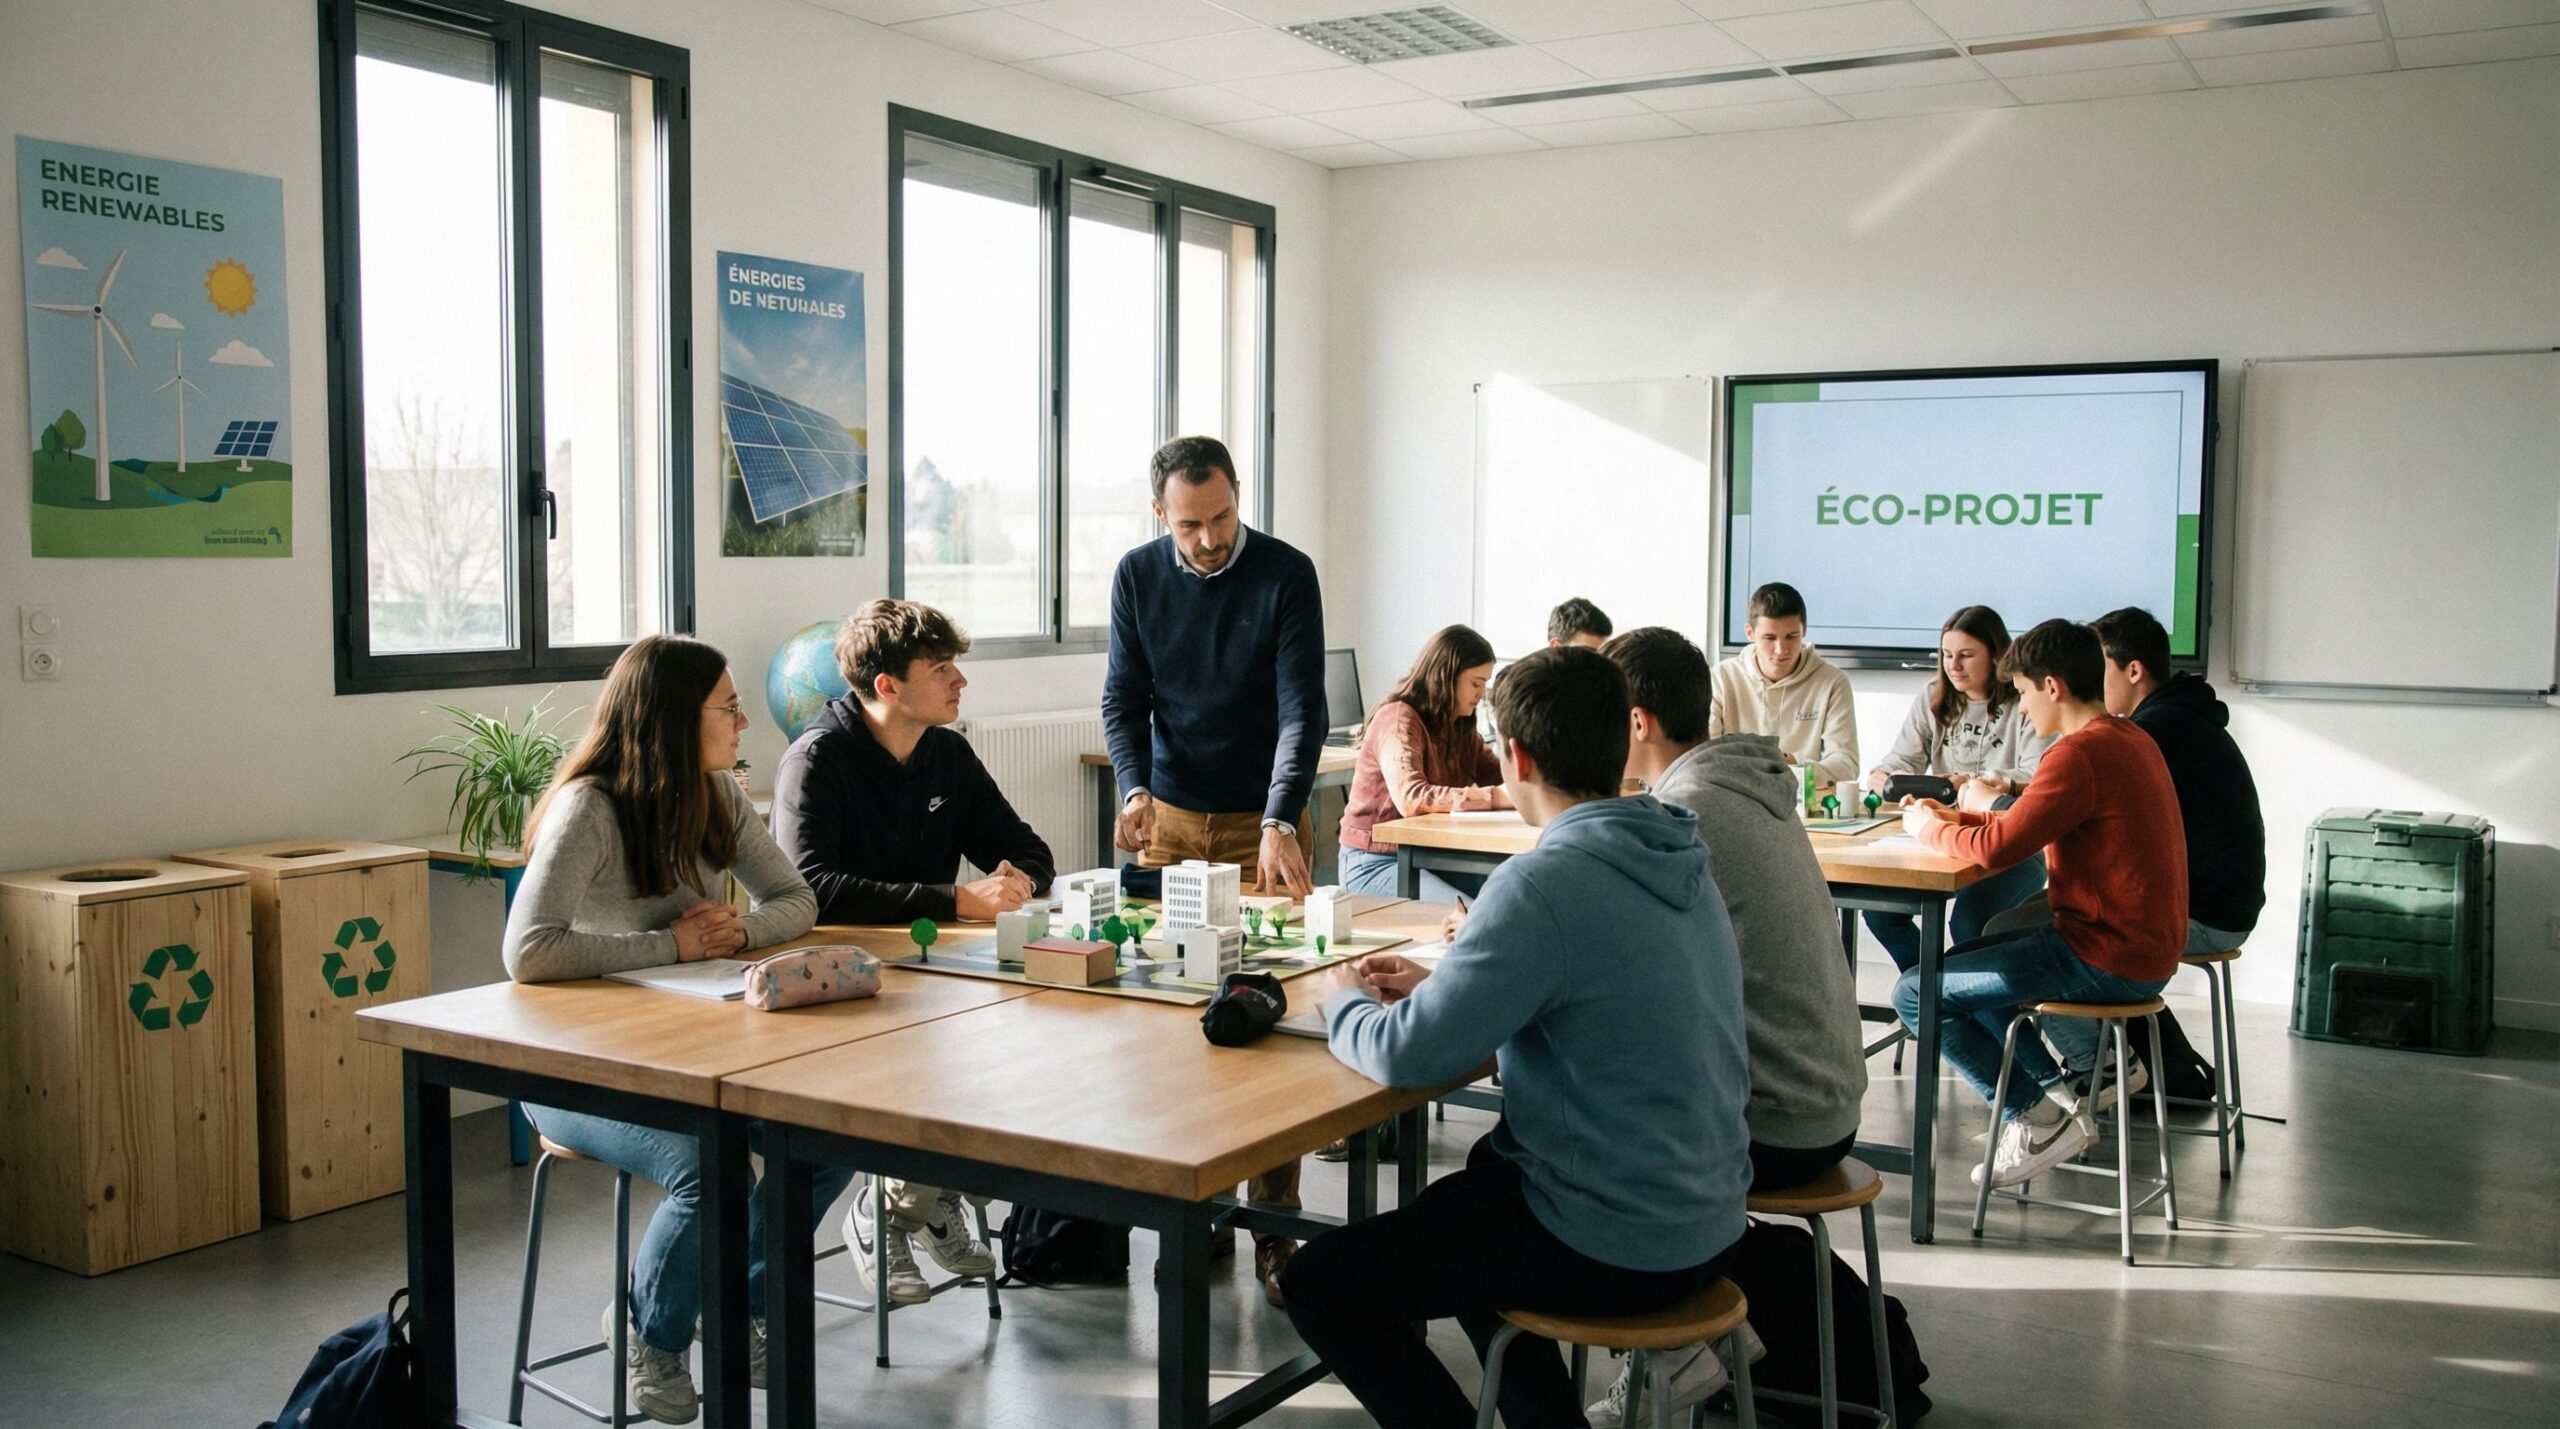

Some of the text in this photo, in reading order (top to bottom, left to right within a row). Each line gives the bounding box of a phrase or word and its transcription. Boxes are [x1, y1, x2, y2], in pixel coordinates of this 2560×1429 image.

[40, 158, 160, 196] ENERGIE
[41, 189, 225, 232] RENEWABLES
[729, 263, 806, 292] ÉNERGIES
[729, 289, 752, 307] DE
[1816, 486, 2103, 526] ÉCO-PROJET
